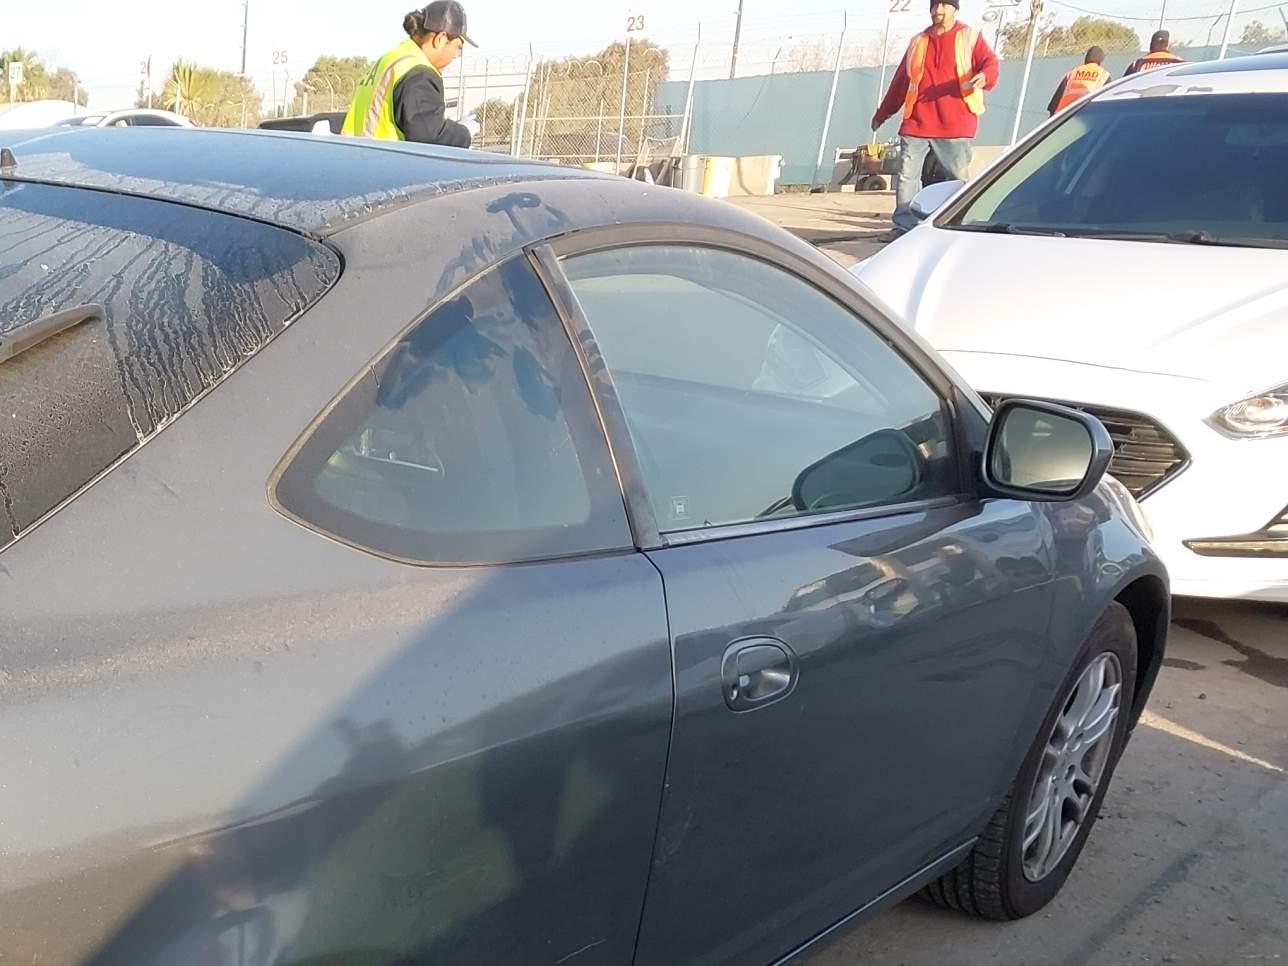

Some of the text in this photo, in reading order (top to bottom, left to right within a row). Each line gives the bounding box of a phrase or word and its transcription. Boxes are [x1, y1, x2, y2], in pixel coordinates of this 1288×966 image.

[888, 0, 912, 13] 22
[626, 15, 644, 32] 23
[272, 49, 288, 65] 25
[10, 66, 21, 80] 27
